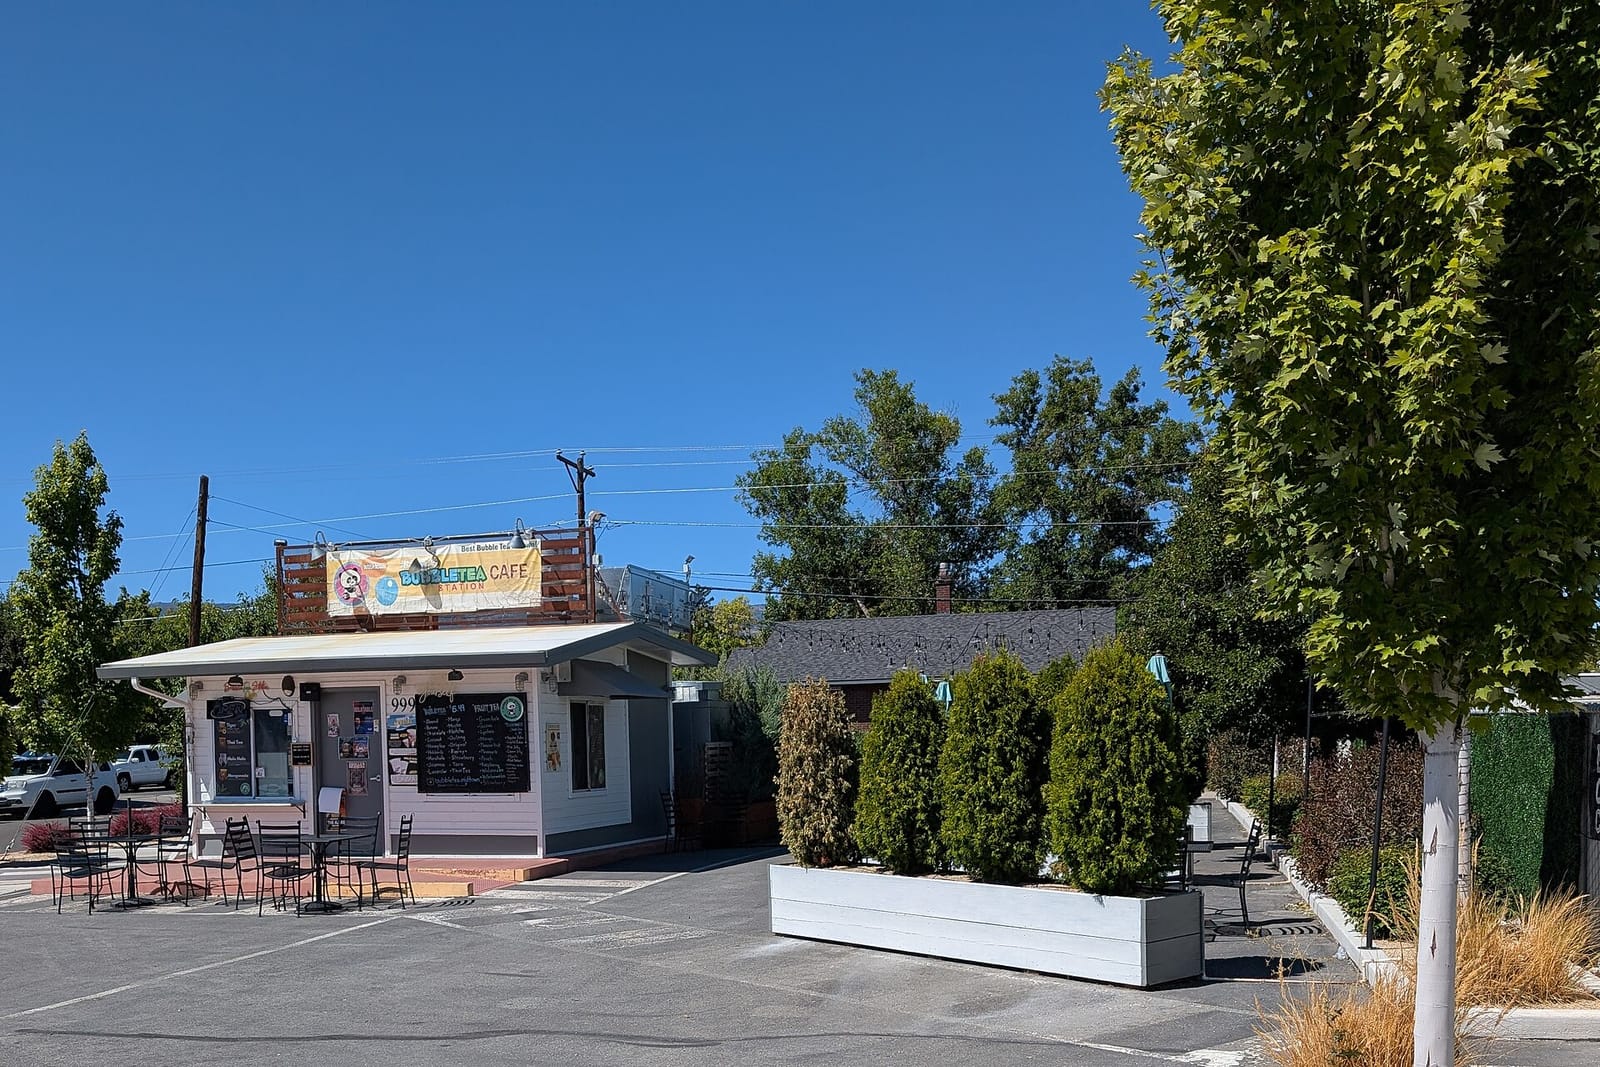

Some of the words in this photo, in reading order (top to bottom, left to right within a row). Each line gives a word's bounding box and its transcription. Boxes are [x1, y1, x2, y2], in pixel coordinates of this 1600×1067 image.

[399, 565, 487, 586] BUBBLETEA
[489, 563, 528, 580] CAFE
[438, 583, 485, 592] STATION
[391, 697, 416, 712] 999
